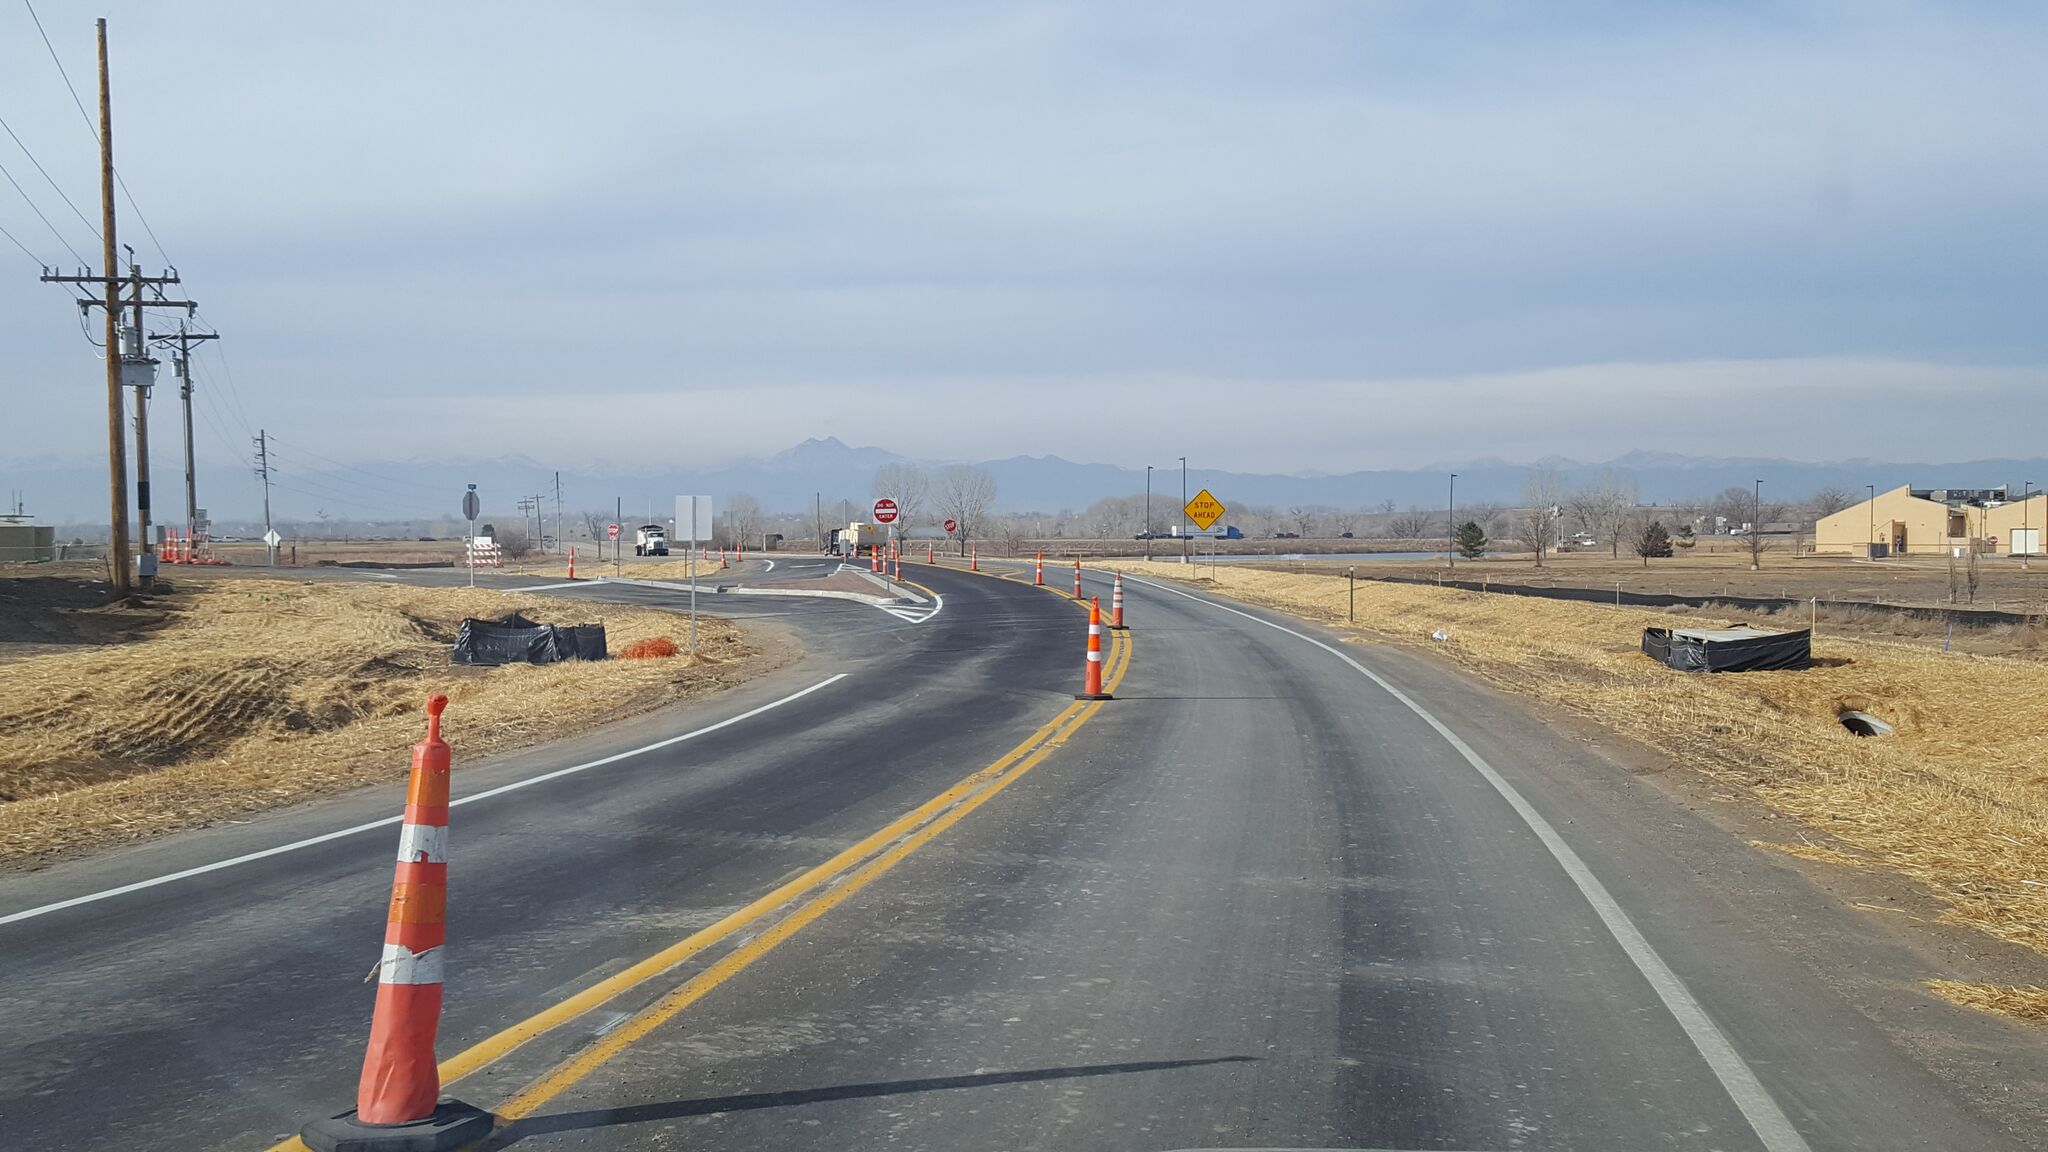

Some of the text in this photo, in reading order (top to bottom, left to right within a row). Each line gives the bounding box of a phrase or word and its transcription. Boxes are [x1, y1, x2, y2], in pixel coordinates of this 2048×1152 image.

[1194, 501, 1215, 509] STOP
[1193, 511, 1216, 519] AHEAD
[944, 521, 955, 530] STOP
